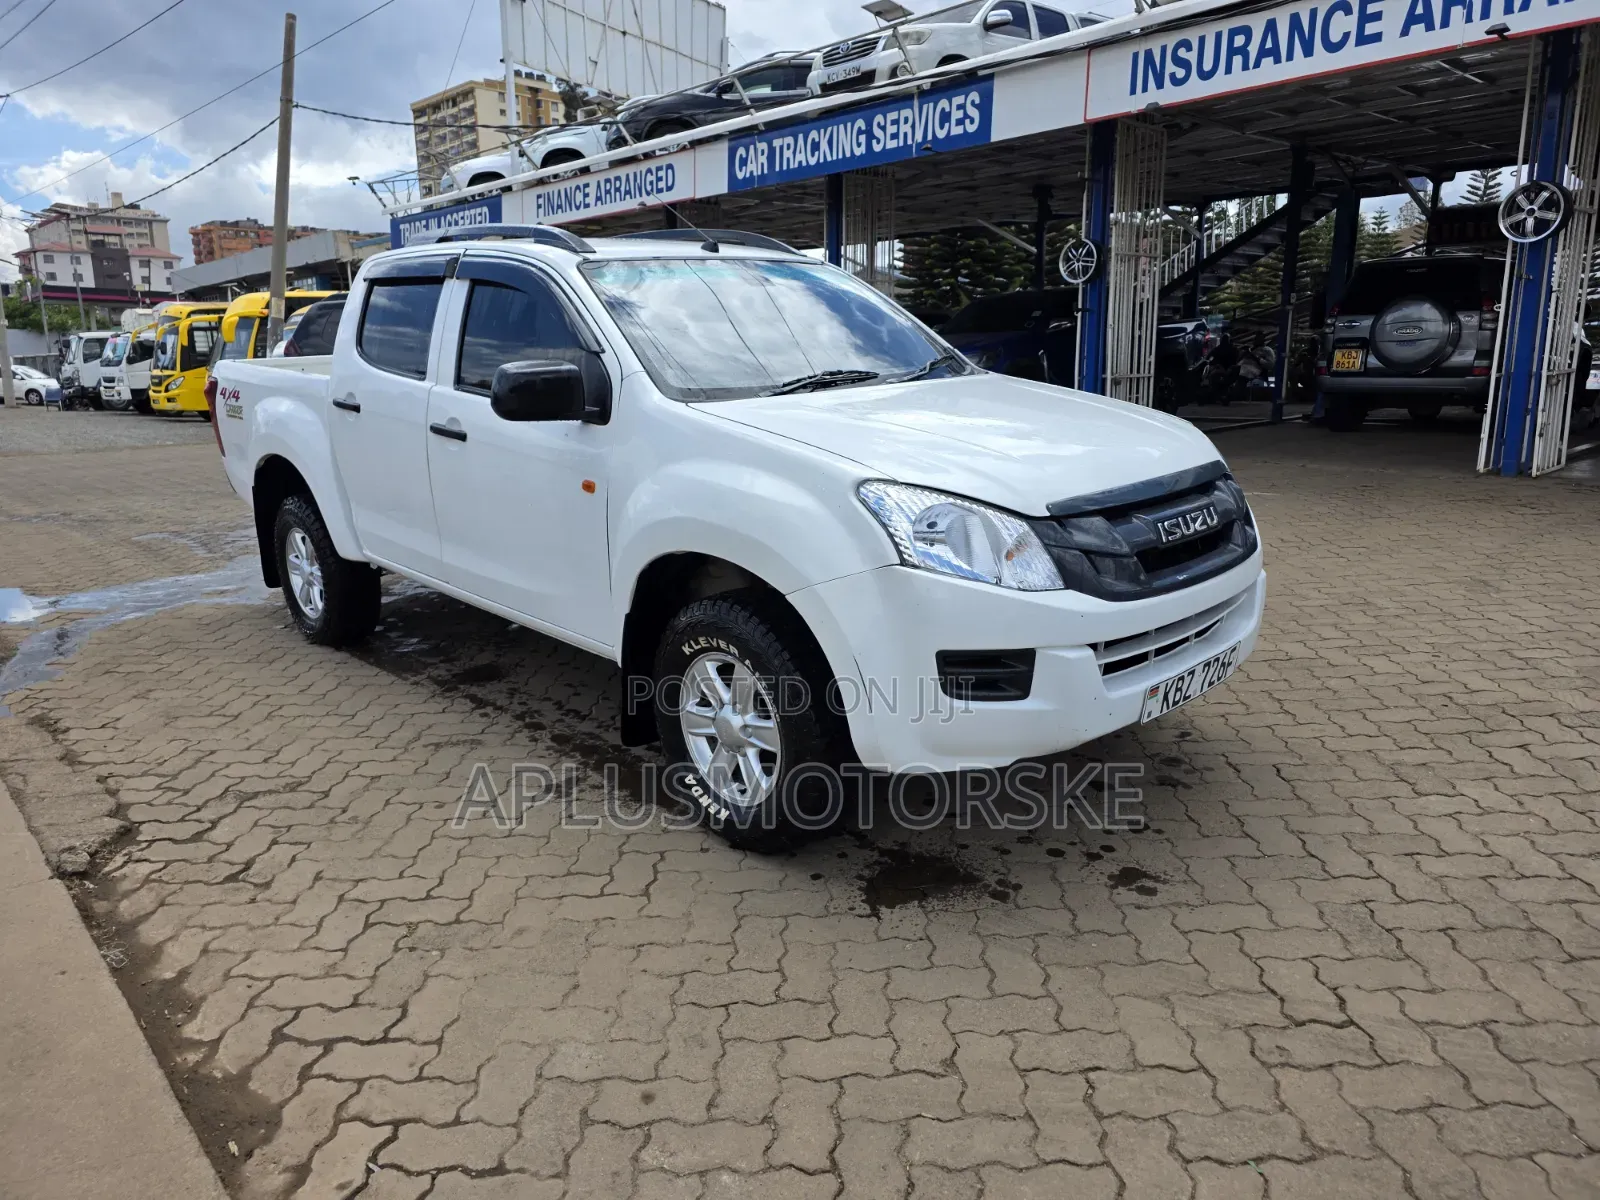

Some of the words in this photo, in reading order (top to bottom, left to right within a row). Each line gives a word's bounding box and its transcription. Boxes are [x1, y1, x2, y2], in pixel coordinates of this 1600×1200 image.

[1128, 0, 1384, 97] INSURANCE
[735, 141, 768, 180] CAR
[773, 118, 867, 172] TRACKING
[872, 91, 980, 152] SERVICES
[536, 182, 591, 219] FINANCE
[594, 162, 676, 208] ARRANGED
[1335, 360, 1356, 369] 861A
[1341, 350, 1358, 360] KBJ
[1157, 506, 1219, 543] ISUZU
[1159, 668, 1196, 714] KBZ
[1200, 645, 1237, 694] 726F
[685, 774, 730, 821] KENDA
